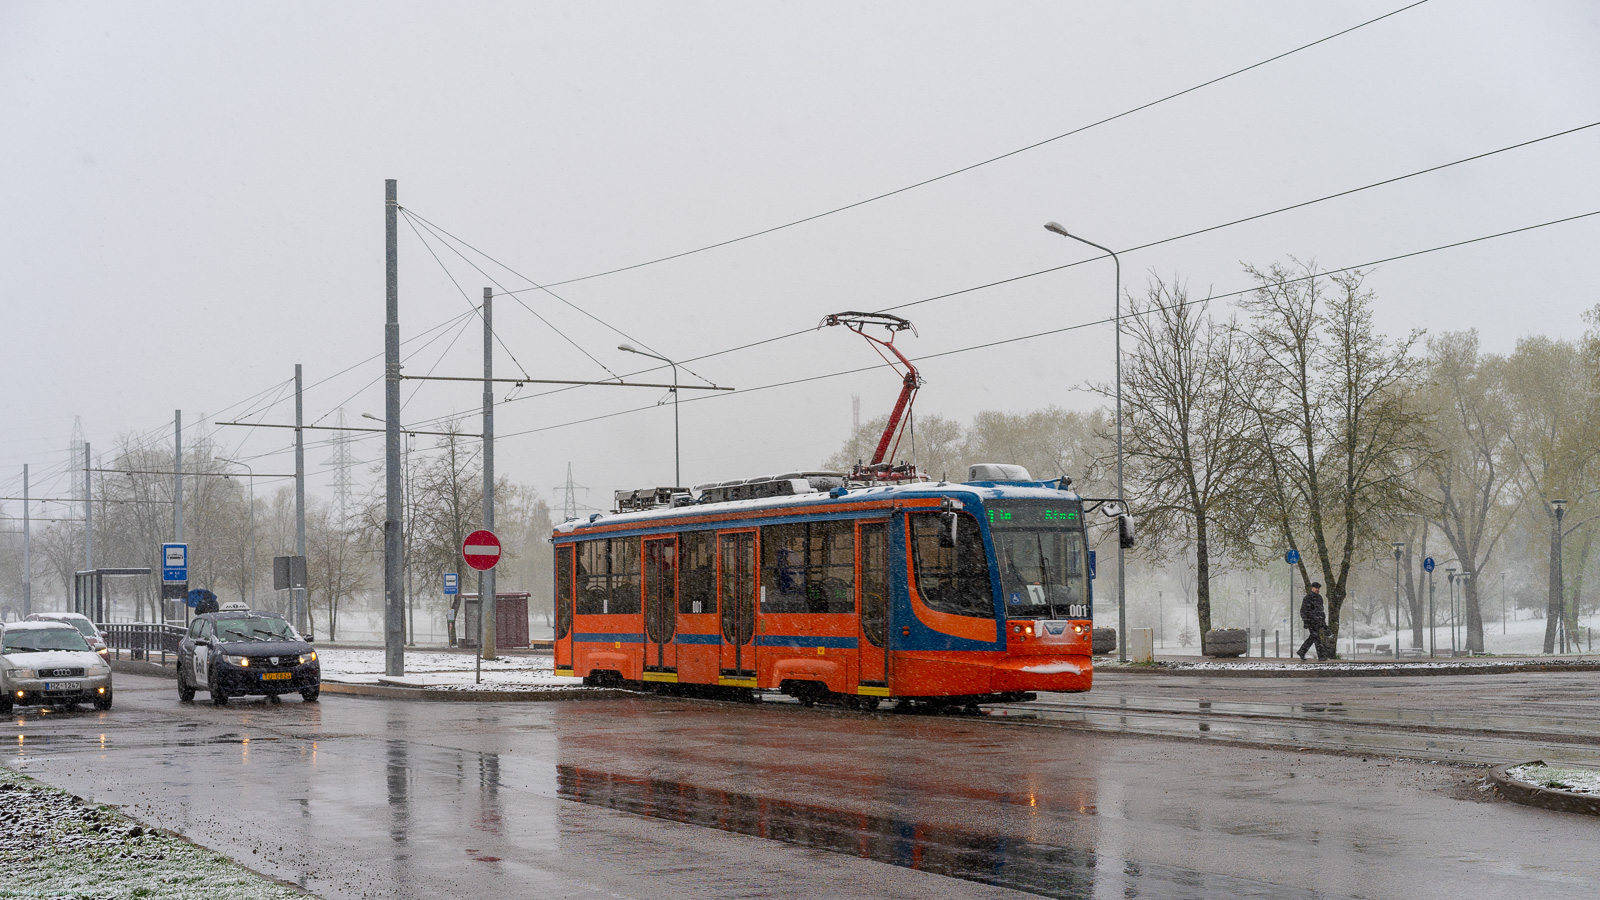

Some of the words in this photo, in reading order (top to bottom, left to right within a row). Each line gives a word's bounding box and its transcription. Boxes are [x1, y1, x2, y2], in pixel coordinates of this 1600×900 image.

[1033, 587, 1042, 603] 1
[692, 600, 702, 613] 001
[1069, 604, 1087, 617] 001
